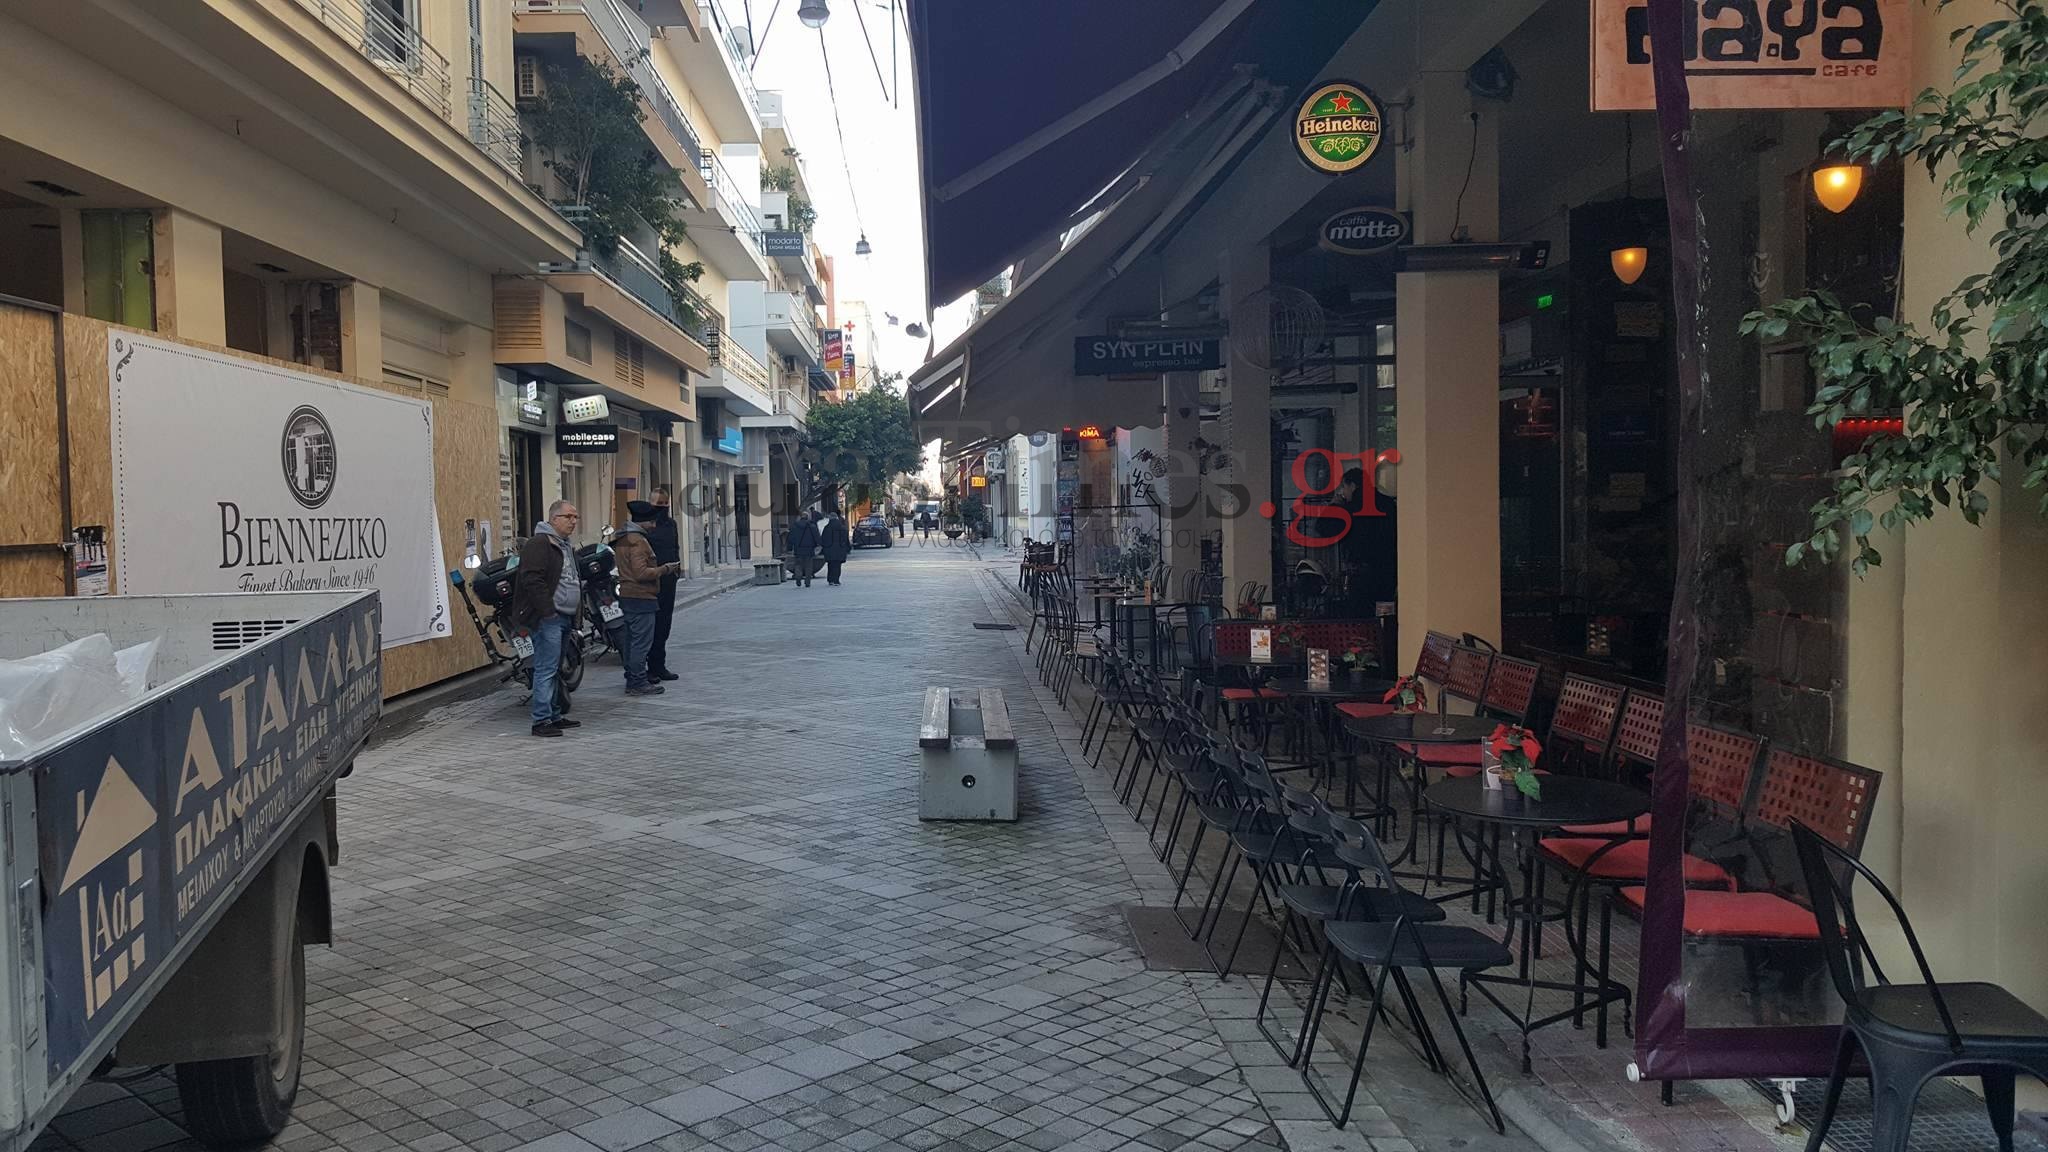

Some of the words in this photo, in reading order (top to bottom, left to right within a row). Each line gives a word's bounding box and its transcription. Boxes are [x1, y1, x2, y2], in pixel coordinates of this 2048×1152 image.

[1822, 65, 1878, 77] cafe
[1303, 116, 1377, 135] Heineken
[1329, 220, 1401, 240] motta
[1092, 341, 1136, 359] SYN
[562, 433, 615, 441] mobilecase
[218, 501, 387, 569] BIENNEZIKO
[322, 565, 351, 590] Since
[352, 562, 378, 588] 1946
[174, 607, 377, 817] ΑΤΑΛΛΑΣ
[176, 746, 283, 876] ΠΛΑΚΑΚΙΑ
[176, 841, 230, 922] ΜΕΙΛΙΧΟΥ
